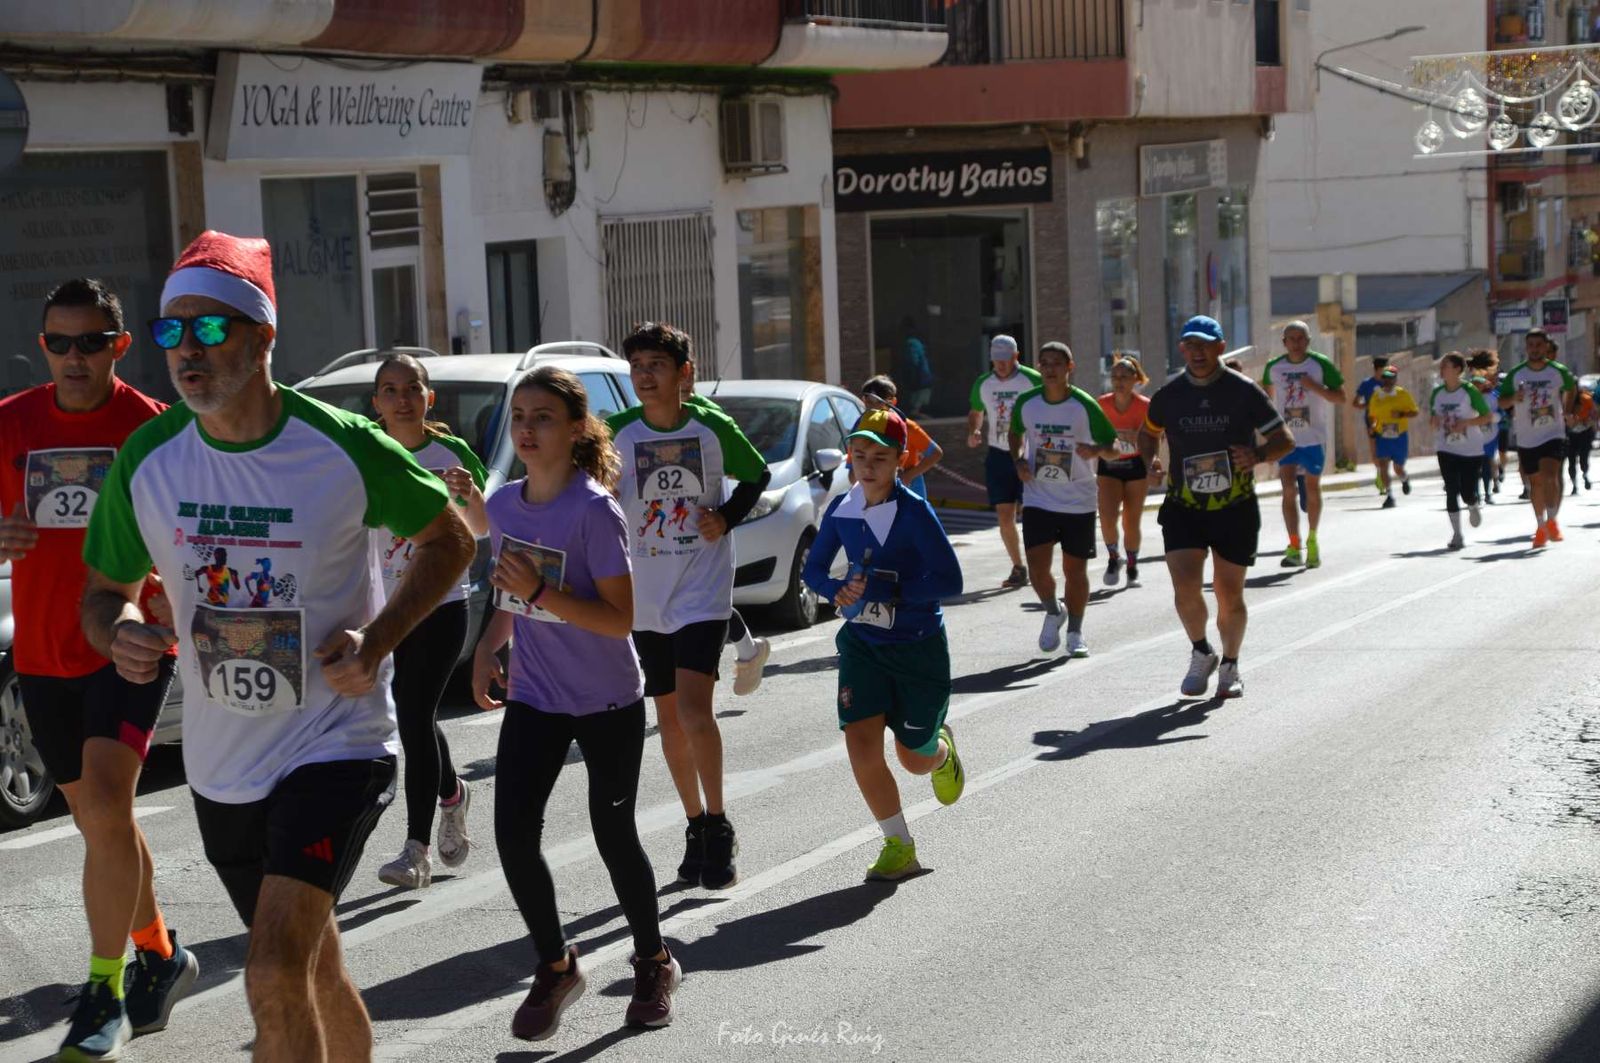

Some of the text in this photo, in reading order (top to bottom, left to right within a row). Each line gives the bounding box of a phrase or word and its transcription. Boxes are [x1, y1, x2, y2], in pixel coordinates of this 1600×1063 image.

[242, 82, 472, 138] YOGA & Wellbeing Centre
[836, 161, 1048, 198] Dorothy Baños
[657, 469, 683, 490] 82
[1044, 466, 1060, 479] 22
[1196, 474, 1221, 489] 277
[55, 491, 88, 517] 32
[200, 503, 226, 519] SAN
[229, 506, 293, 523] SILVESTRE
[216, 663, 276, 702] 159
